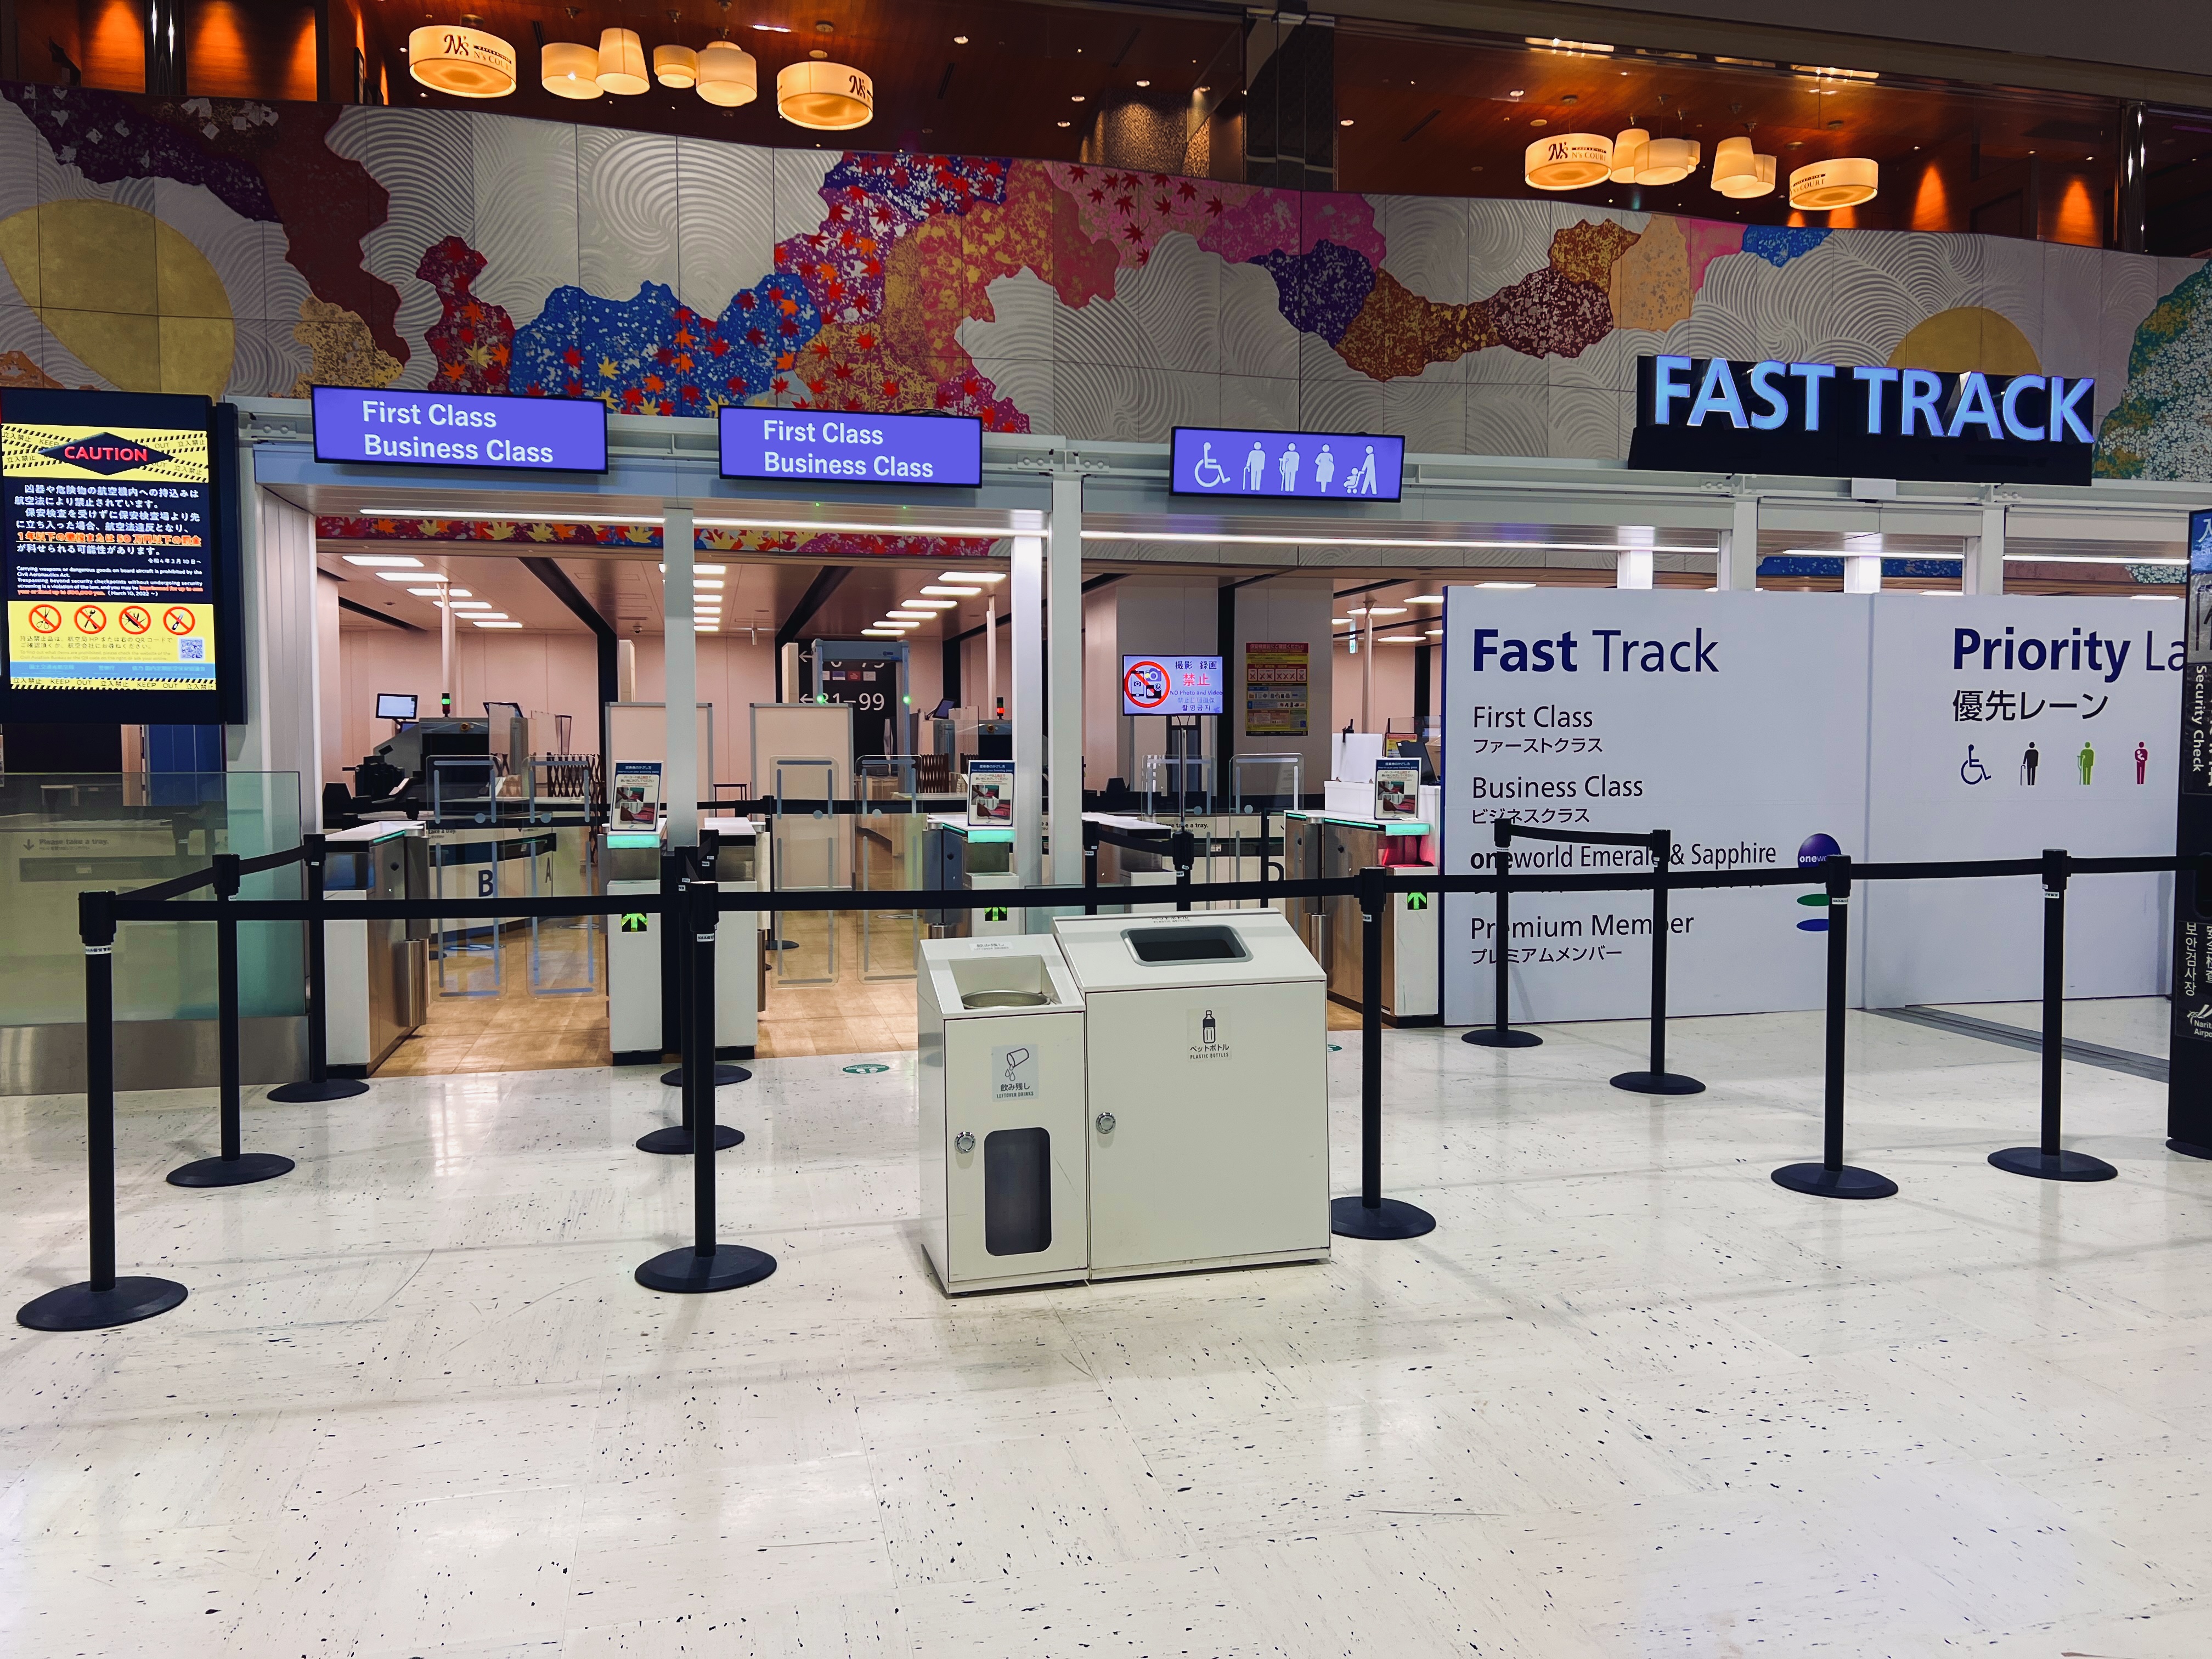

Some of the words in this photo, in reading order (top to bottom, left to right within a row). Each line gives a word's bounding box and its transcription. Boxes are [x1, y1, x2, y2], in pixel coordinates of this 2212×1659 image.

[1654, 354, 1836, 432] FAST
[1853, 365, 2095, 444] TRACK
[362, 400, 421, 425] First
[428, 403, 497, 428] Class
[764, 419, 816, 442] First
[822, 422, 883, 445] Class
[64, 446, 148, 462] CAUTION
[364, 433, 479, 460] Business
[486, 439, 554, 463] Class
[765, 450, 866, 475] Business
[873, 455, 933, 478] Class
[1474, 628, 1578, 672] Fast
[1592, 627, 1719, 673] Track
[1954, 626, 2131, 683] Priority
[1175, 661, 1193, 669] 撮影
[1200, 661, 1217, 669] 録画
[1183, 673, 1210, 686] 禁止
[1953, 689, 2109, 722] 優先レーン
[2192, 665, 2207, 725] Security
[1474, 706, 1526, 728] First
[1533, 704, 1593, 728] Class
[1474, 737, 1603, 753] ファーストクラス
[2193, 730, 2205, 772] Check
[1473, 776, 1577, 798] Business
[1584, 774, 1643, 797] Class
[1472, 808, 1590, 824] ビジネスクラス
[1670, 844, 1684, 865] &
[1691, 842, 1777, 869] Sapphire
[478, 870, 494, 897] B
[1471, 916, 1582, 939] Prmium
[1592, 915, 1695, 936] Memer
[2184, 922, 2198, 996] 보안검사장
[1190, 1043, 1229, 1053] ペットボトル
[1000, 1082, 1030, 1092] 飲み残し
